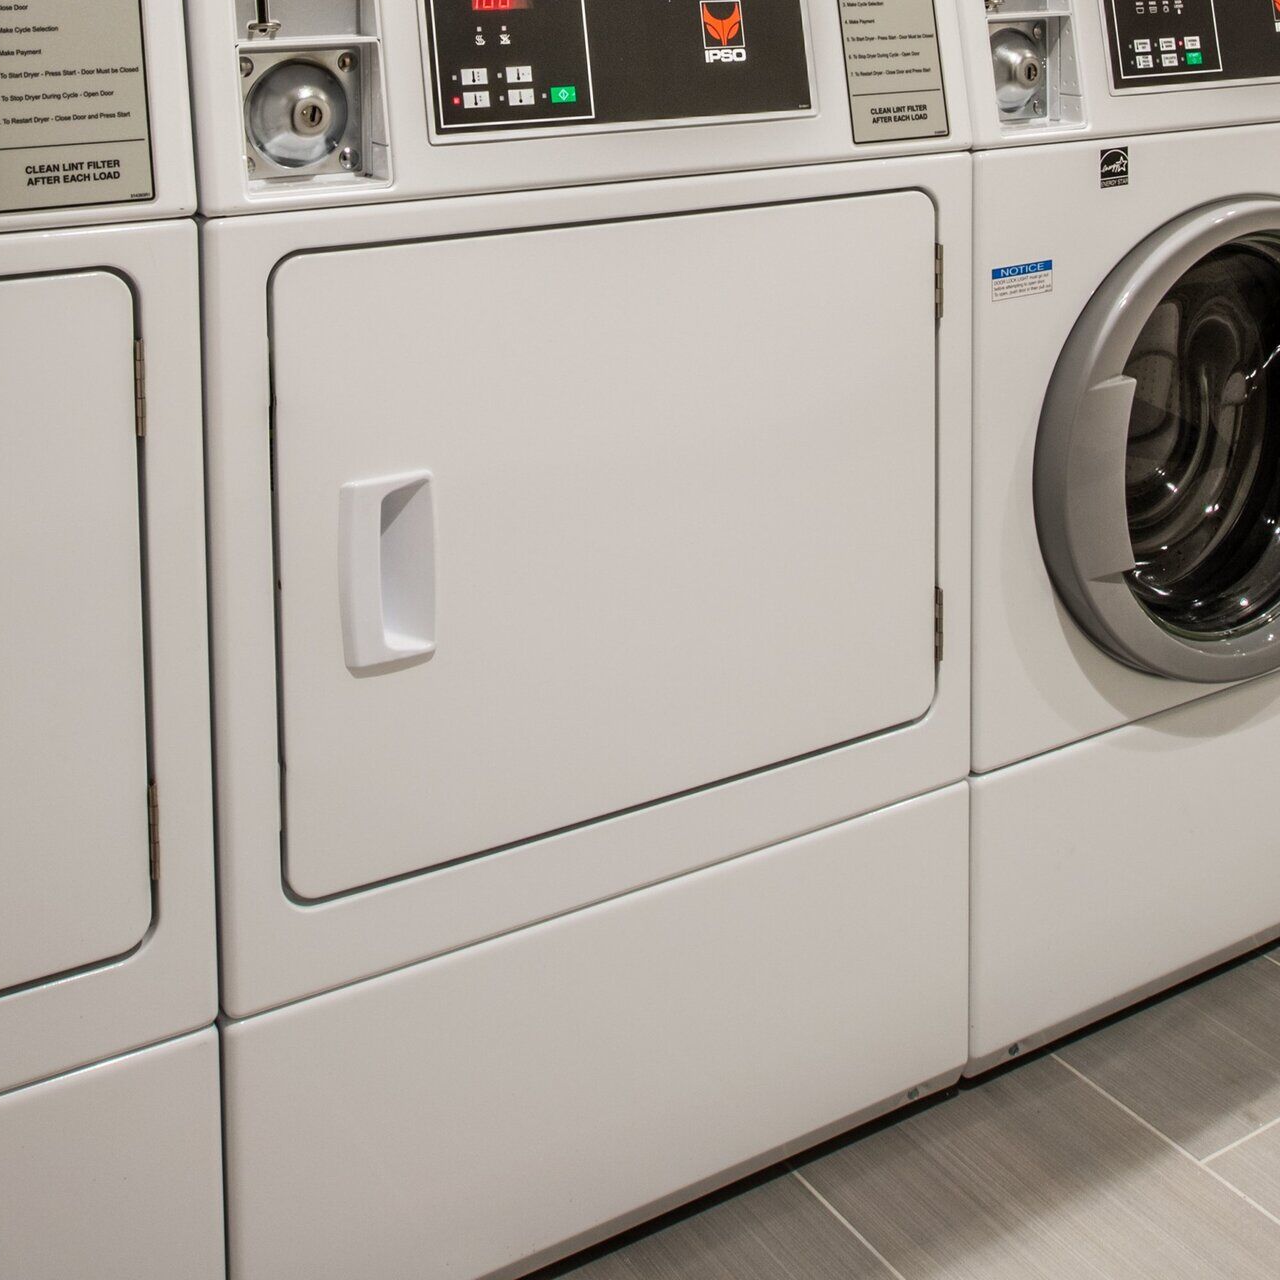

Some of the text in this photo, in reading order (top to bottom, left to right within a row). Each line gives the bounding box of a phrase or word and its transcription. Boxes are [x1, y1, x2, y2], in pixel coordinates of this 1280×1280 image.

[14, 26, 30, 34] Cycle
[15, 48, 41, 57] Payment
[705, 48, 746, 63] IPSO
[23, 71, 39, 80] Dryer
[25, 94, 40, 102] Dryer
[41, 93, 60, 101] During
[62, 92, 78, 100] Cycle
[83, 91, 98, 99] Open
[870, 107, 891, 115] CLEAN
[907, 104, 927, 113] FILTER
[11, 116, 32, 124] Restart
[33, 116, 49, 124] Dryer
[55, 114, 70, 122] Close
[872, 116, 892, 124] AFTER
[911, 113, 927, 121] LOAD
[25, 159, 120, 174] CLEAN LINT FILTER
[27, 171, 120, 186] AFTER EACH LOAD
[1001, 263, 1045, 277] NOTICE
